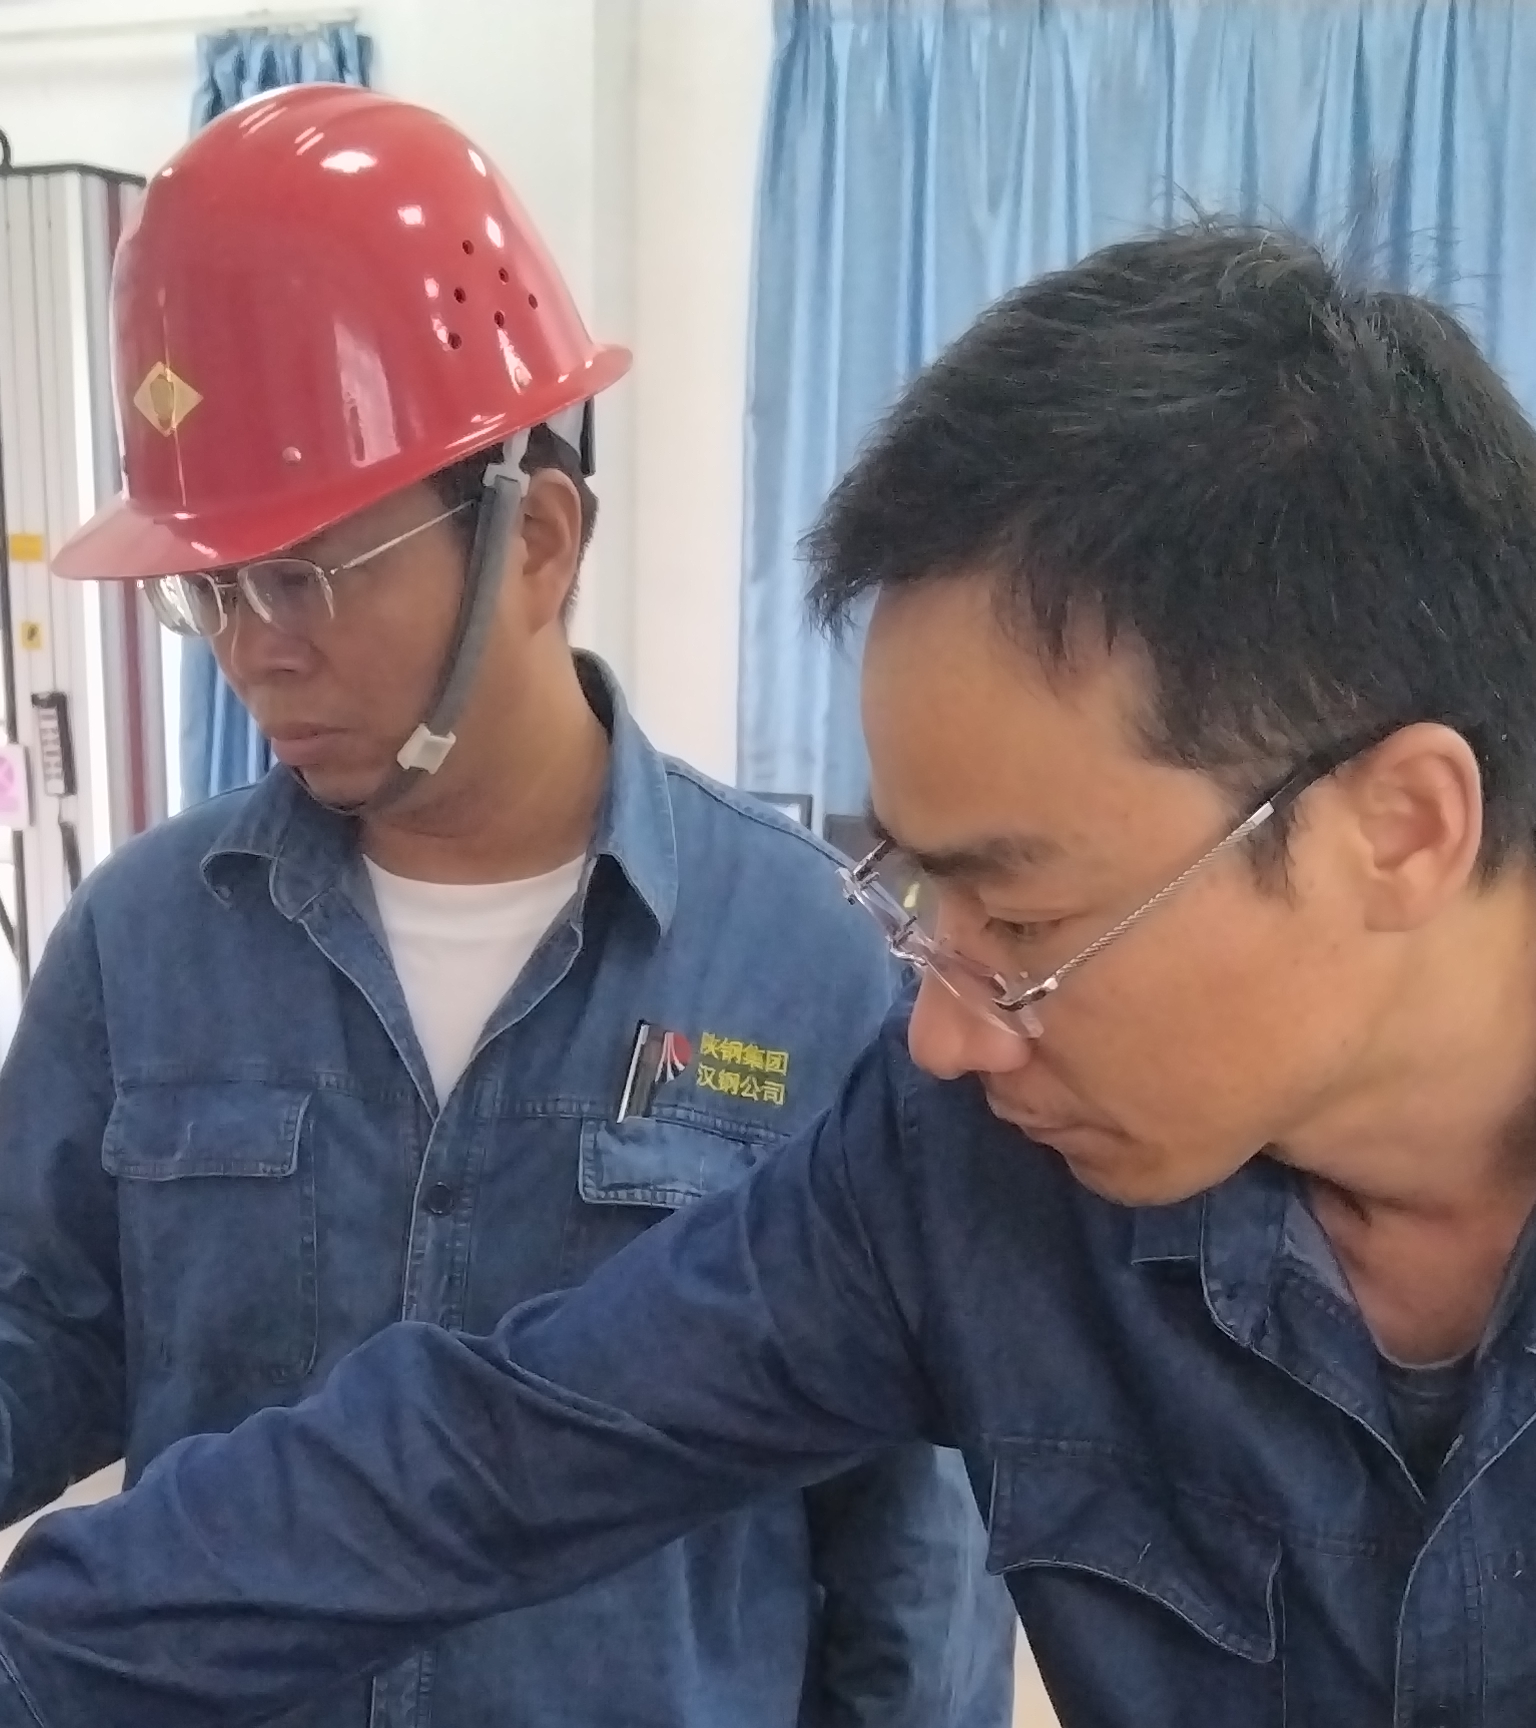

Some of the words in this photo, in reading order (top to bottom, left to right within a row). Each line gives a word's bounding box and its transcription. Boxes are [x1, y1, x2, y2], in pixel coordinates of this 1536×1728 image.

[700, 1032, 789, 1076] 陕钢集团
[696, 1062, 785, 1105] 汉钢公司
